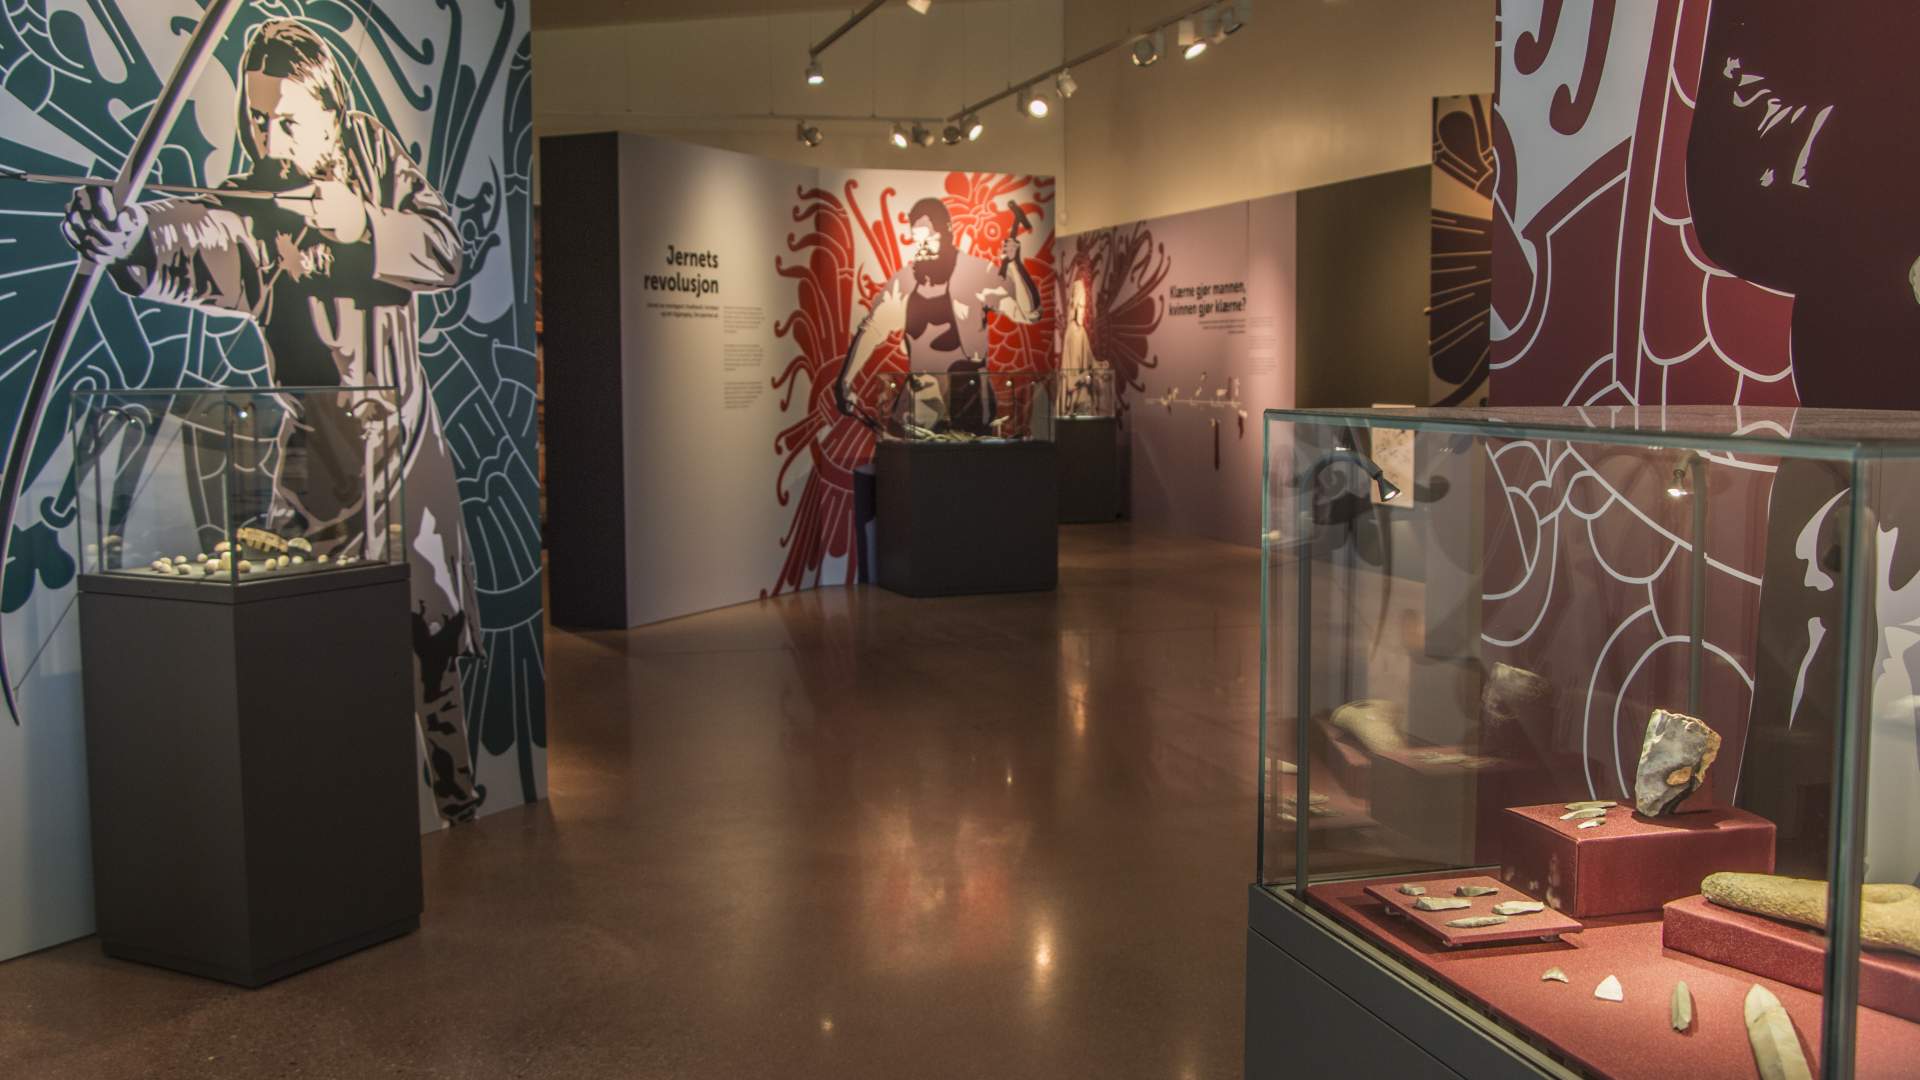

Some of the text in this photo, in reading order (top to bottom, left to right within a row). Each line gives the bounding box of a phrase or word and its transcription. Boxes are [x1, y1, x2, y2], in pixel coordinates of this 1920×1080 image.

[667, 245, 719, 269] Jernets
[644, 273, 719, 298] revolusjon
[1170, 285, 1195, 298] Klærne
[1196, 284, 1211, 300] gjør
[1169, 297, 1247, 317] kvinnen gjør klærne?
